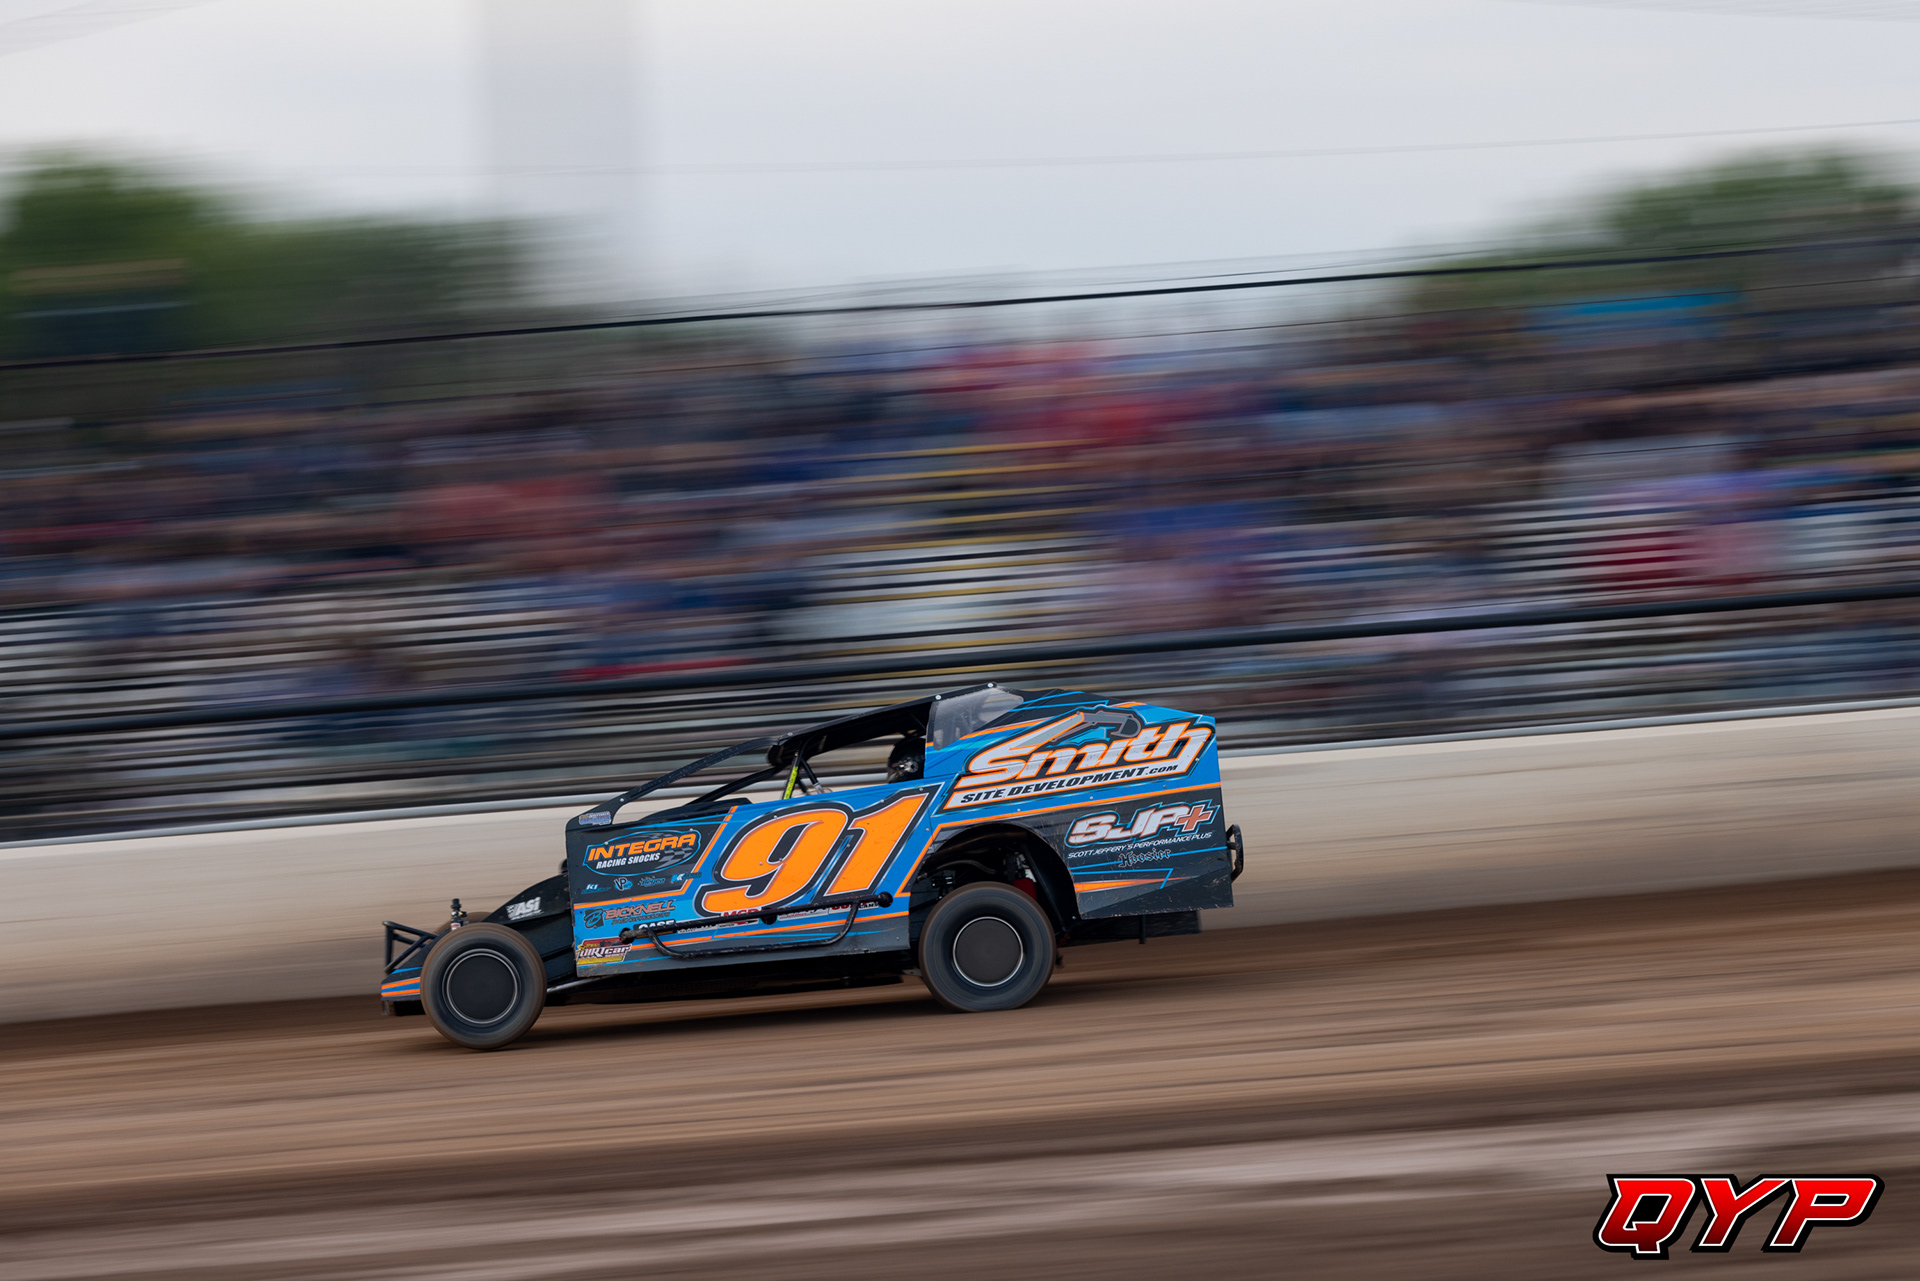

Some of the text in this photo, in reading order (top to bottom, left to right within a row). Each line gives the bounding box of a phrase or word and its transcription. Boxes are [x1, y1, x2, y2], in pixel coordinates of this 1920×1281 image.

[960, 711, 1213, 787] Smith
[960, 787, 1006, 804] SITE
[587, 833, 697, 861] INTEGRA
[701, 791, 930, 914] 91
[1067, 849, 1095, 860] SCOTT
[1132, 836, 1191, 850] PERFORMANCE
[1190, 831, 1213, 842] PLUS
[595, 852, 661, 870] RACING SHOCKS
[1118, 848, 1172, 868] Hoosier
[614, 877, 628, 891] VP
[605, 899, 677, 920] BICKNELL
